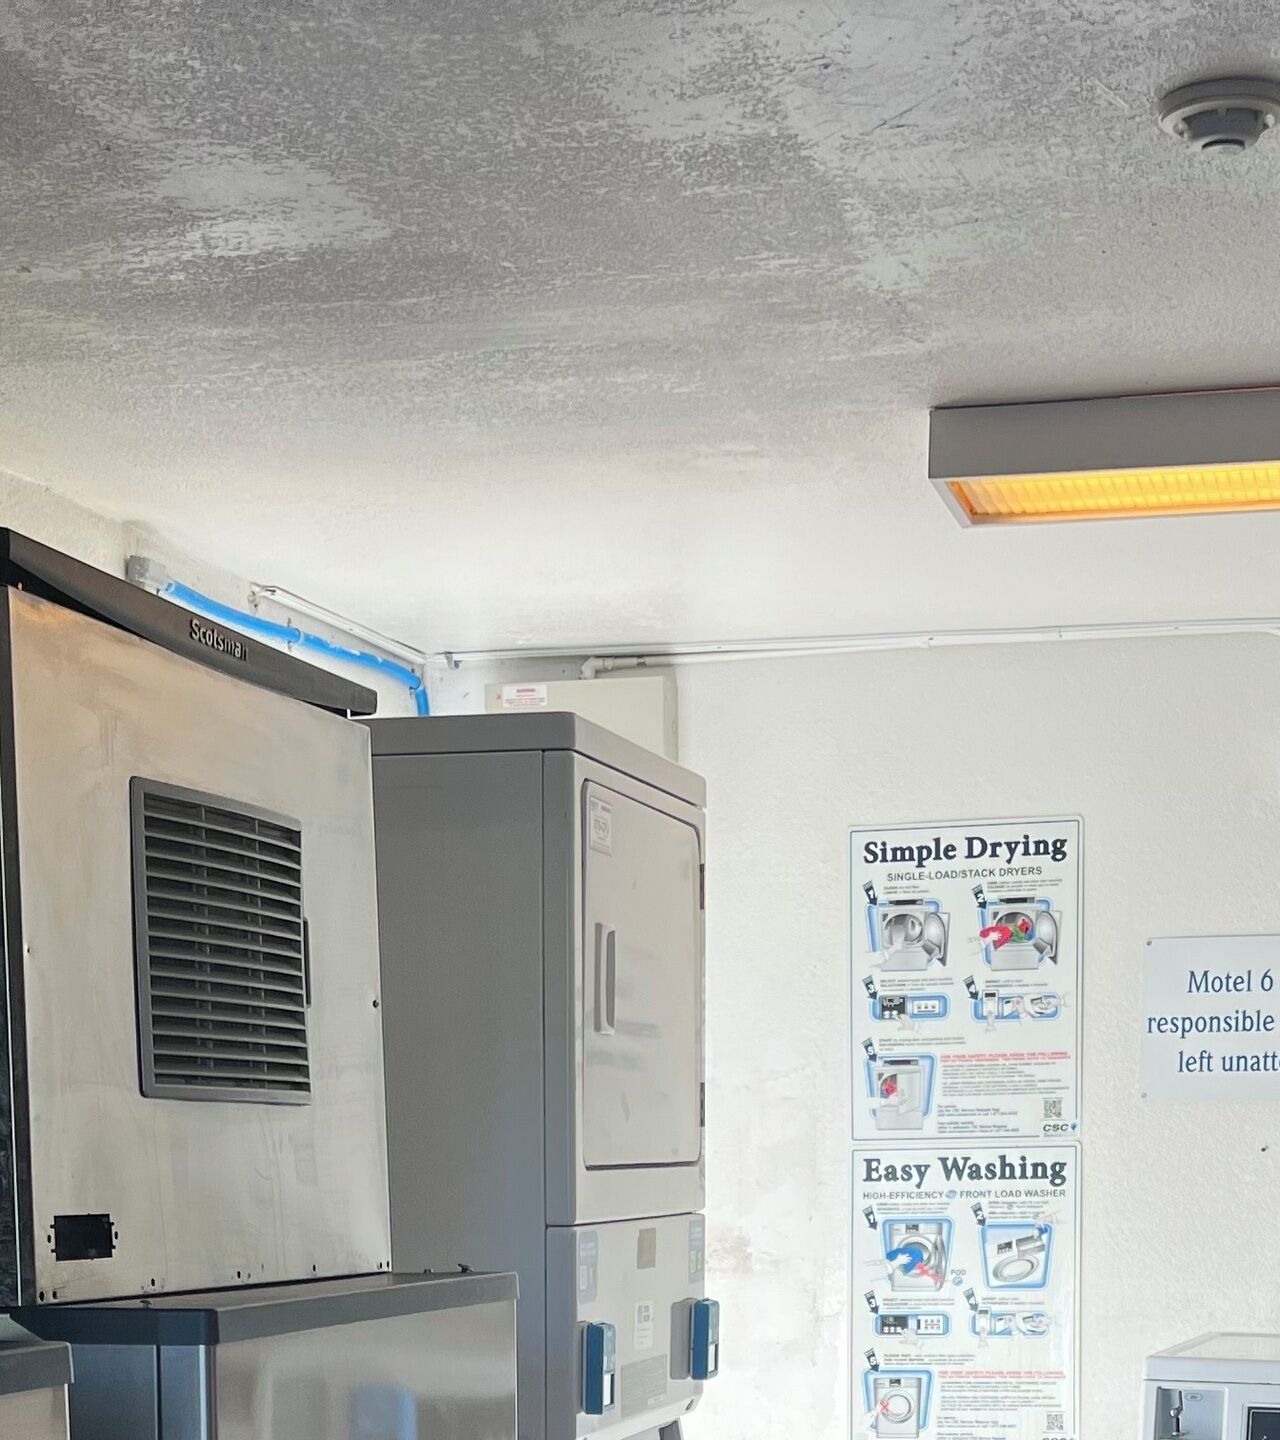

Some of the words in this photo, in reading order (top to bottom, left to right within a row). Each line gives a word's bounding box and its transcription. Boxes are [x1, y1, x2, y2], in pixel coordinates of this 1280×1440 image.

[189, 618, 249, 661] Scotsman
[863, 836, 957, 867] Simple
[965, 835, 1068, 864] Drying
[887, 867, 995, 882] SINGLE-LOAD/STACK
[999, 866, 1043, 879] DRYERS
[1187, 969, 1252, 993] Motel
[1260, 968, 1273, 992] 6
[1147, 1010, 1275, 1039] responsible
[1178, 1050, 1213, 1073] left
[1043, 1123, 1070, 1132] CSC
[862, 1157, 931, 1188] Easy
[938, 1154, 1068, 1186] Washing
[863, 1190, 944, 1200] HIGH-EFFICIENCY
[960, 1190, 992, 1199] FRONT
[995, 1189, 1022, 1198] LOAD
[1024, 1188, 1066, 1198] WASHER
